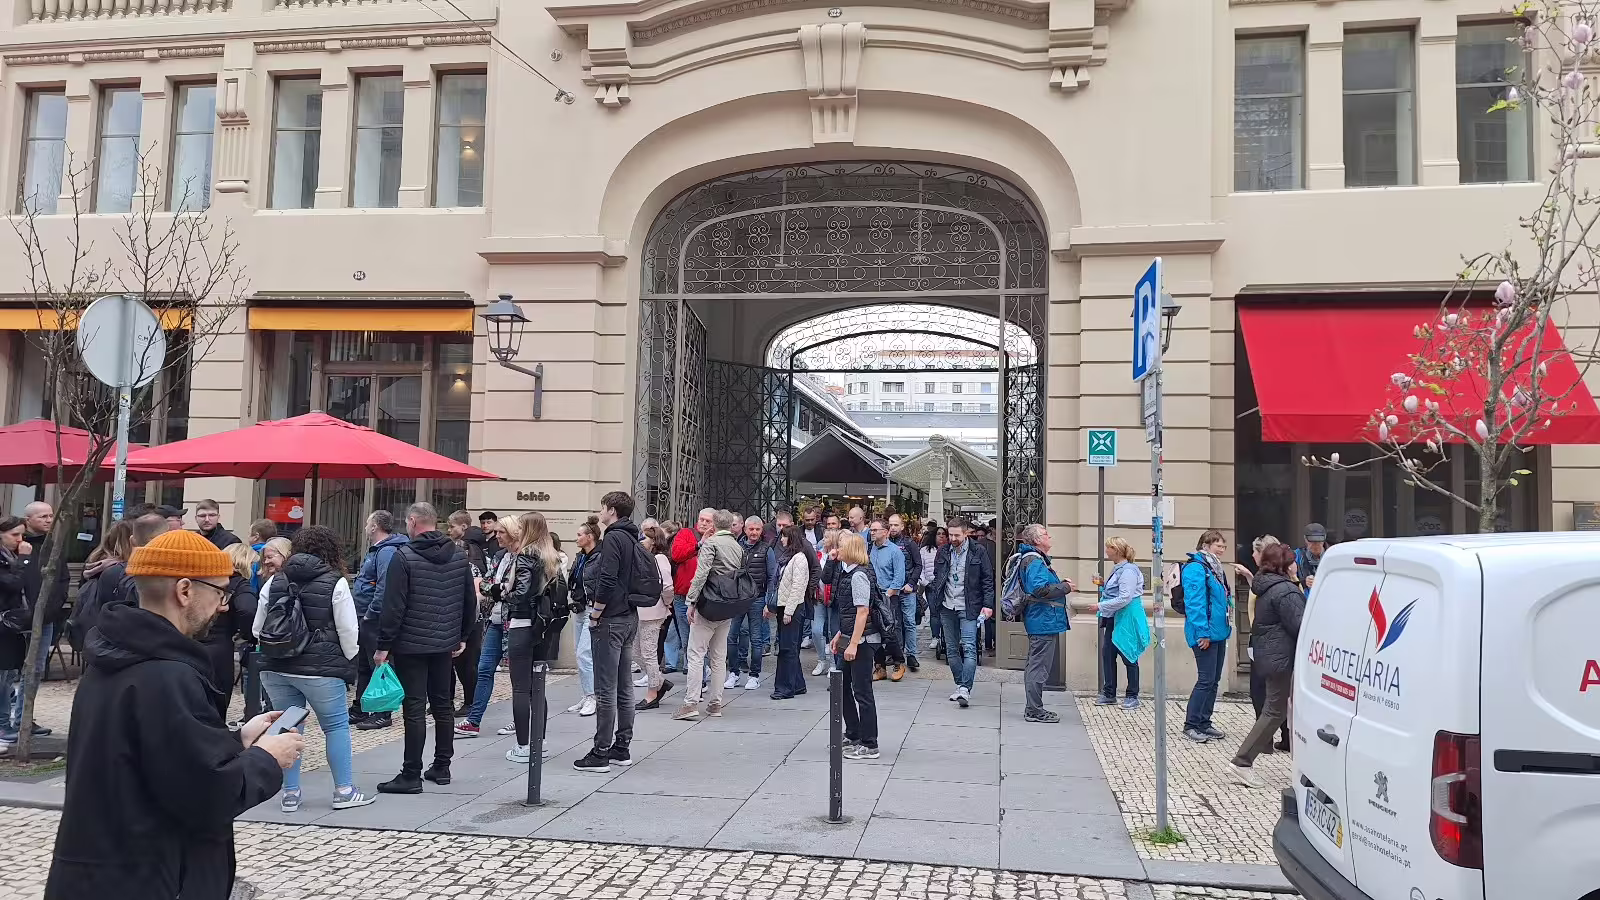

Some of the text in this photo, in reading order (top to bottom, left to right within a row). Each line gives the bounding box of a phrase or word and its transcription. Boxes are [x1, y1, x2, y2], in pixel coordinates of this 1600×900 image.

[1138, 280, 1154, 368] P
[517, 491, 550, 501] Bolhão
[1368, 798, 1398, 818] PEUGEOT
[1352, 819, 1408, 852] www.asahotelaria.pt
